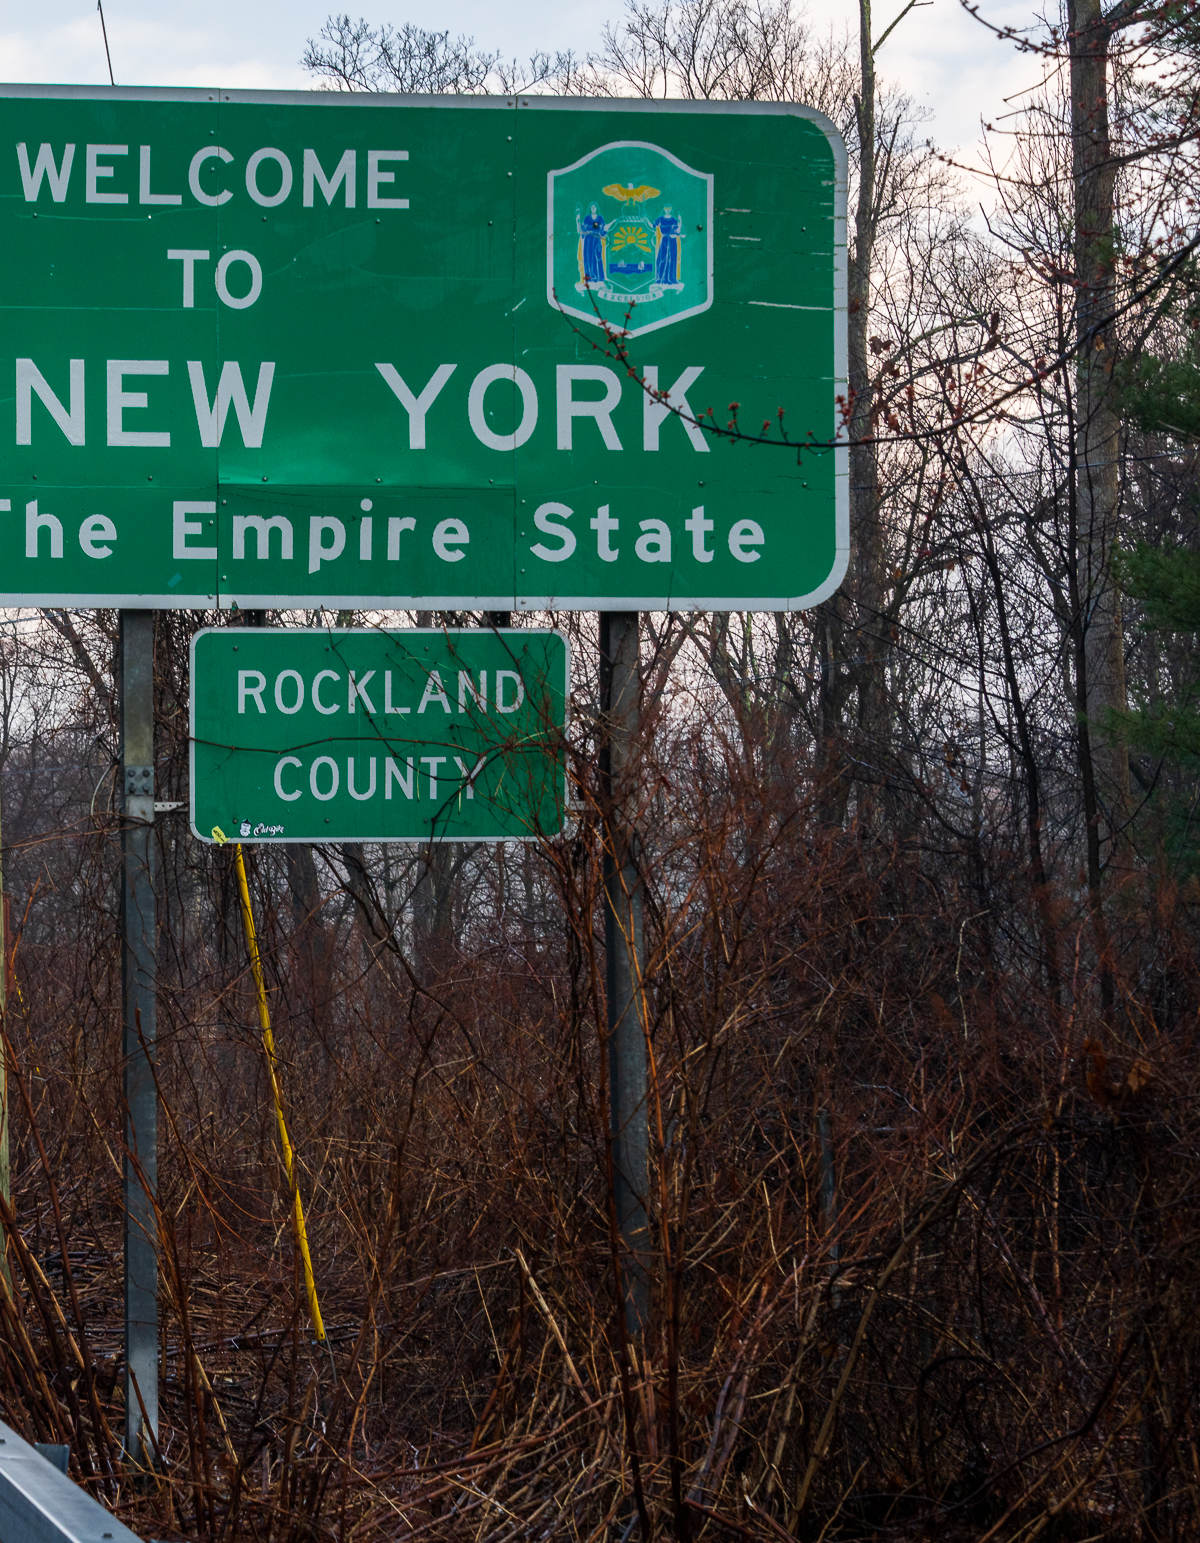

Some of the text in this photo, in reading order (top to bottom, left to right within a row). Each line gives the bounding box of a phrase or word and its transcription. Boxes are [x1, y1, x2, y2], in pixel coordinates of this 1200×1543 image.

[16, 142, 410, 209] WELCOME
[167, 249, 262, 309] TO
[603, 293, 657, 302] EXCELSIOR
[16, 358, 711, 452] NEW YORK
[173, 498, 470, 574] Empire
[529, 501, 765, 563] State
[237, 669, 525, 715] ROCKLAND
[273, 756, 488, 801] COUNTY
